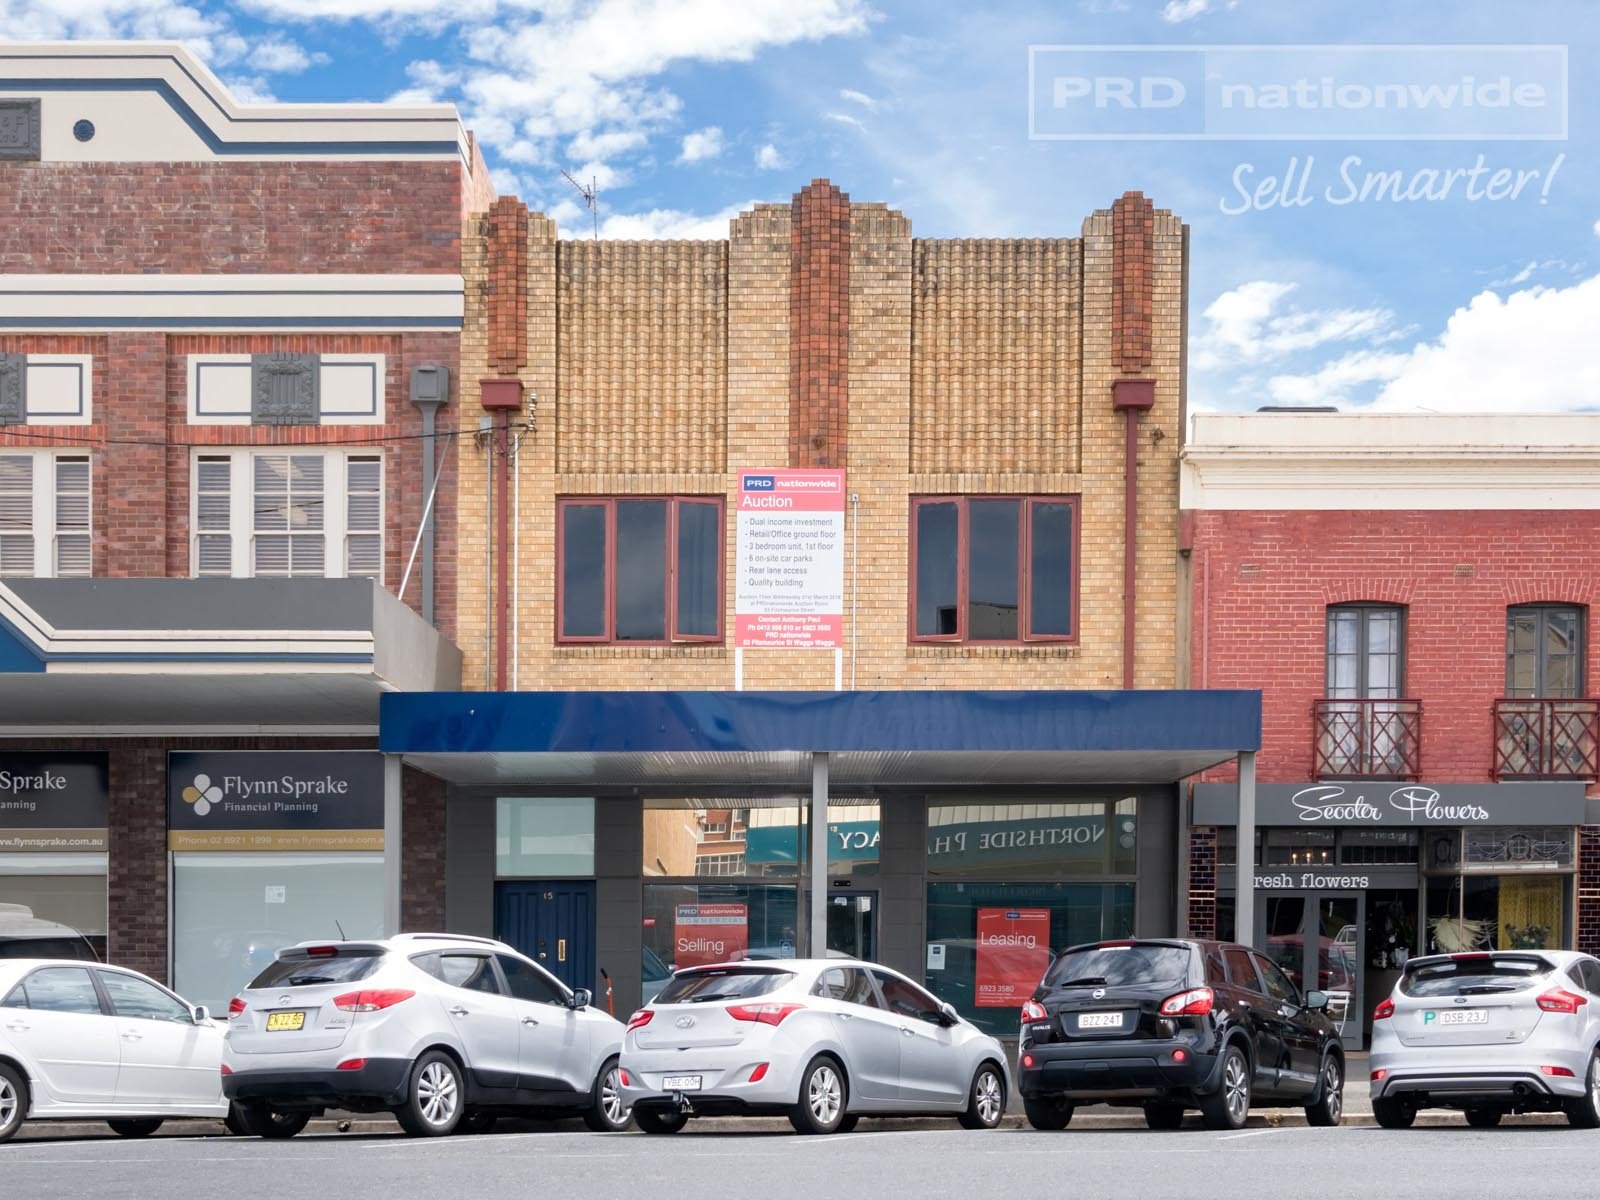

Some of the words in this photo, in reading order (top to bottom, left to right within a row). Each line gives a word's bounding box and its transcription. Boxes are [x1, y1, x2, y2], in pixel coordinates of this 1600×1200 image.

[777, 480, 837, 488] nationwide
[742, 495, 793, 508] Auction
[749, 518, 765, 526] Dual
[767, 518, 793, 526] income
[794, 518, 833, 526] investment
[749, 530, 792, 538] Retail/Office
[793, 530, 819, 540] ground
[820, 530, 836, 538] floor
[793, 555, 813, 564] parks
[748, 578, 773, 588] Quality
[775, 578, 803, 588] building
[0, 800, 36, 812] anning
[224, 802, 271, 812] Financial
[274, 802, 318, 813] Planning
[1291, 786, 1382, 821] Scooter
[1389, 786, 1489, 822] Flowers
[1253, 873, 1292, 888] resh
[1300, 873, 1369, 888] flowers
[543, 891, 554, 901] 15
[980, 931, 1036, 949] Leasing
[677, 937, 724, 955] Selling
[997, 984, 1015, 992] 3580
[1083, 1015, 1101, 1026] BZZ
[1103, 1015, 1121, 1026] 24T
[1423, 1010, 1437, 1026] P
[1443, 1011, 1464, 1024] DSB
[1466, 1010, 1487, 1023] 23J
